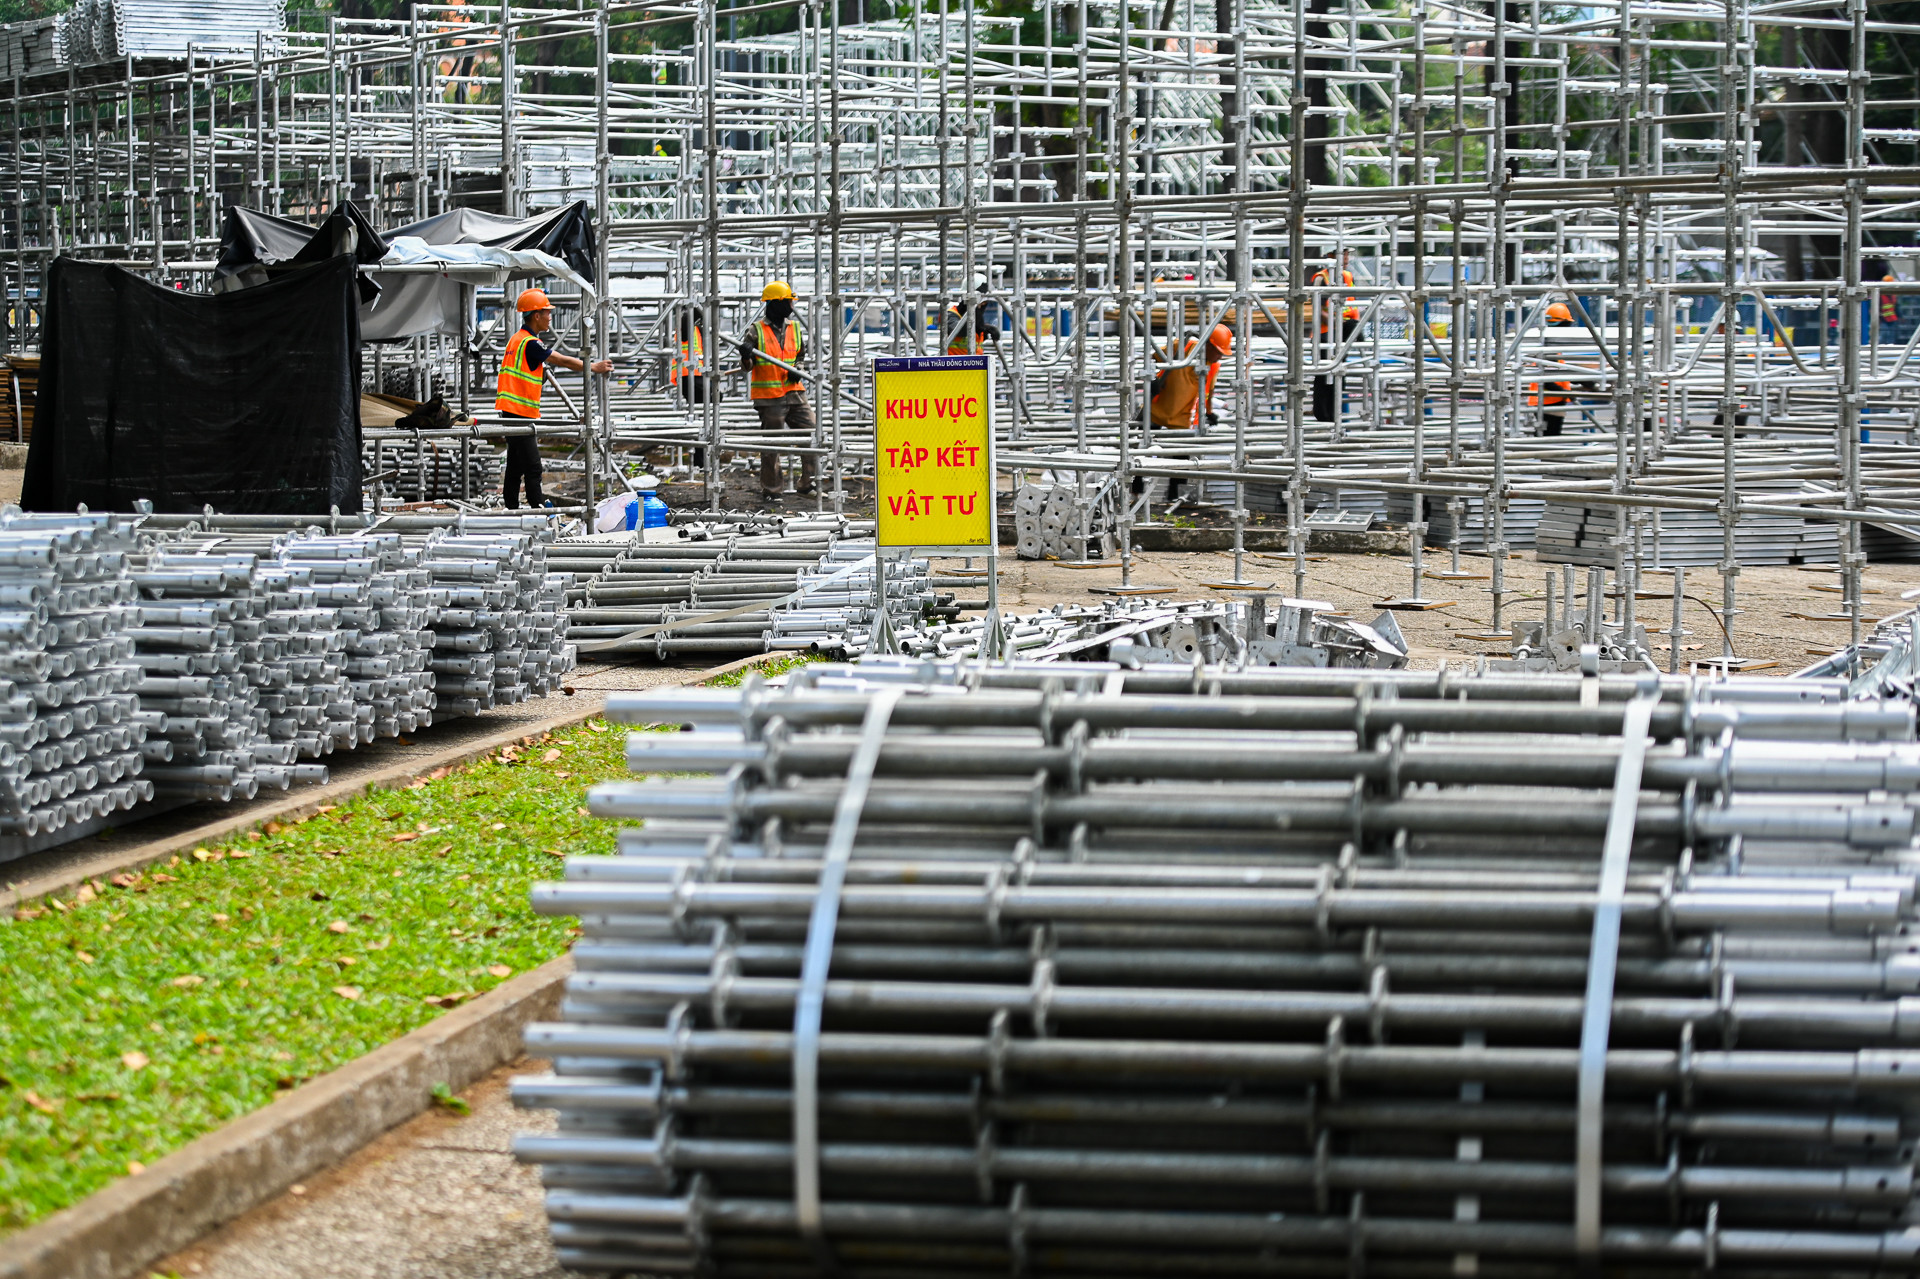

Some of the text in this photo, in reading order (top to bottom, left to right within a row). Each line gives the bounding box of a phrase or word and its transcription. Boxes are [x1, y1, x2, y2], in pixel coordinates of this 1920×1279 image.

[886, 394, 978, 423] KHU VỰC
[886, 440, 980, 473] TẬP KẾT
[888, 489, 977, 521] VẬT TƯ
